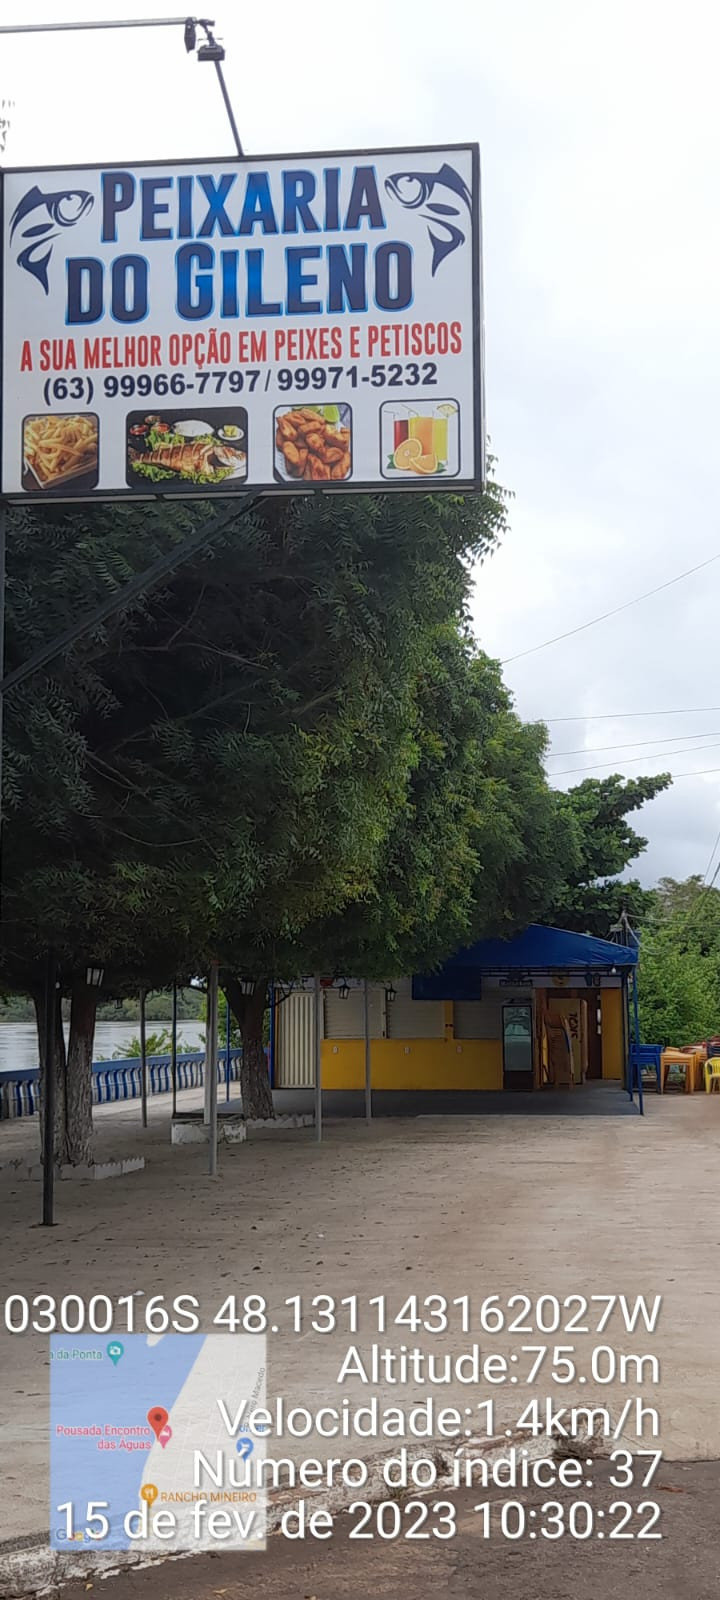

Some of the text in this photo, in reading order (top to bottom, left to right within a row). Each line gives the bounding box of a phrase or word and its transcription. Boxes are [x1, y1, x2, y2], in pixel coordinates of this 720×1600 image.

[100, 165, 386, 243] PEIXARIA
[65, 241, 415, 326] DO GILENO
[20, 321, 462, 375] A SUA MELHOR OPÇÃO EM PEIXES E PETISCOS
[43, 375, 94, 405] (63)
